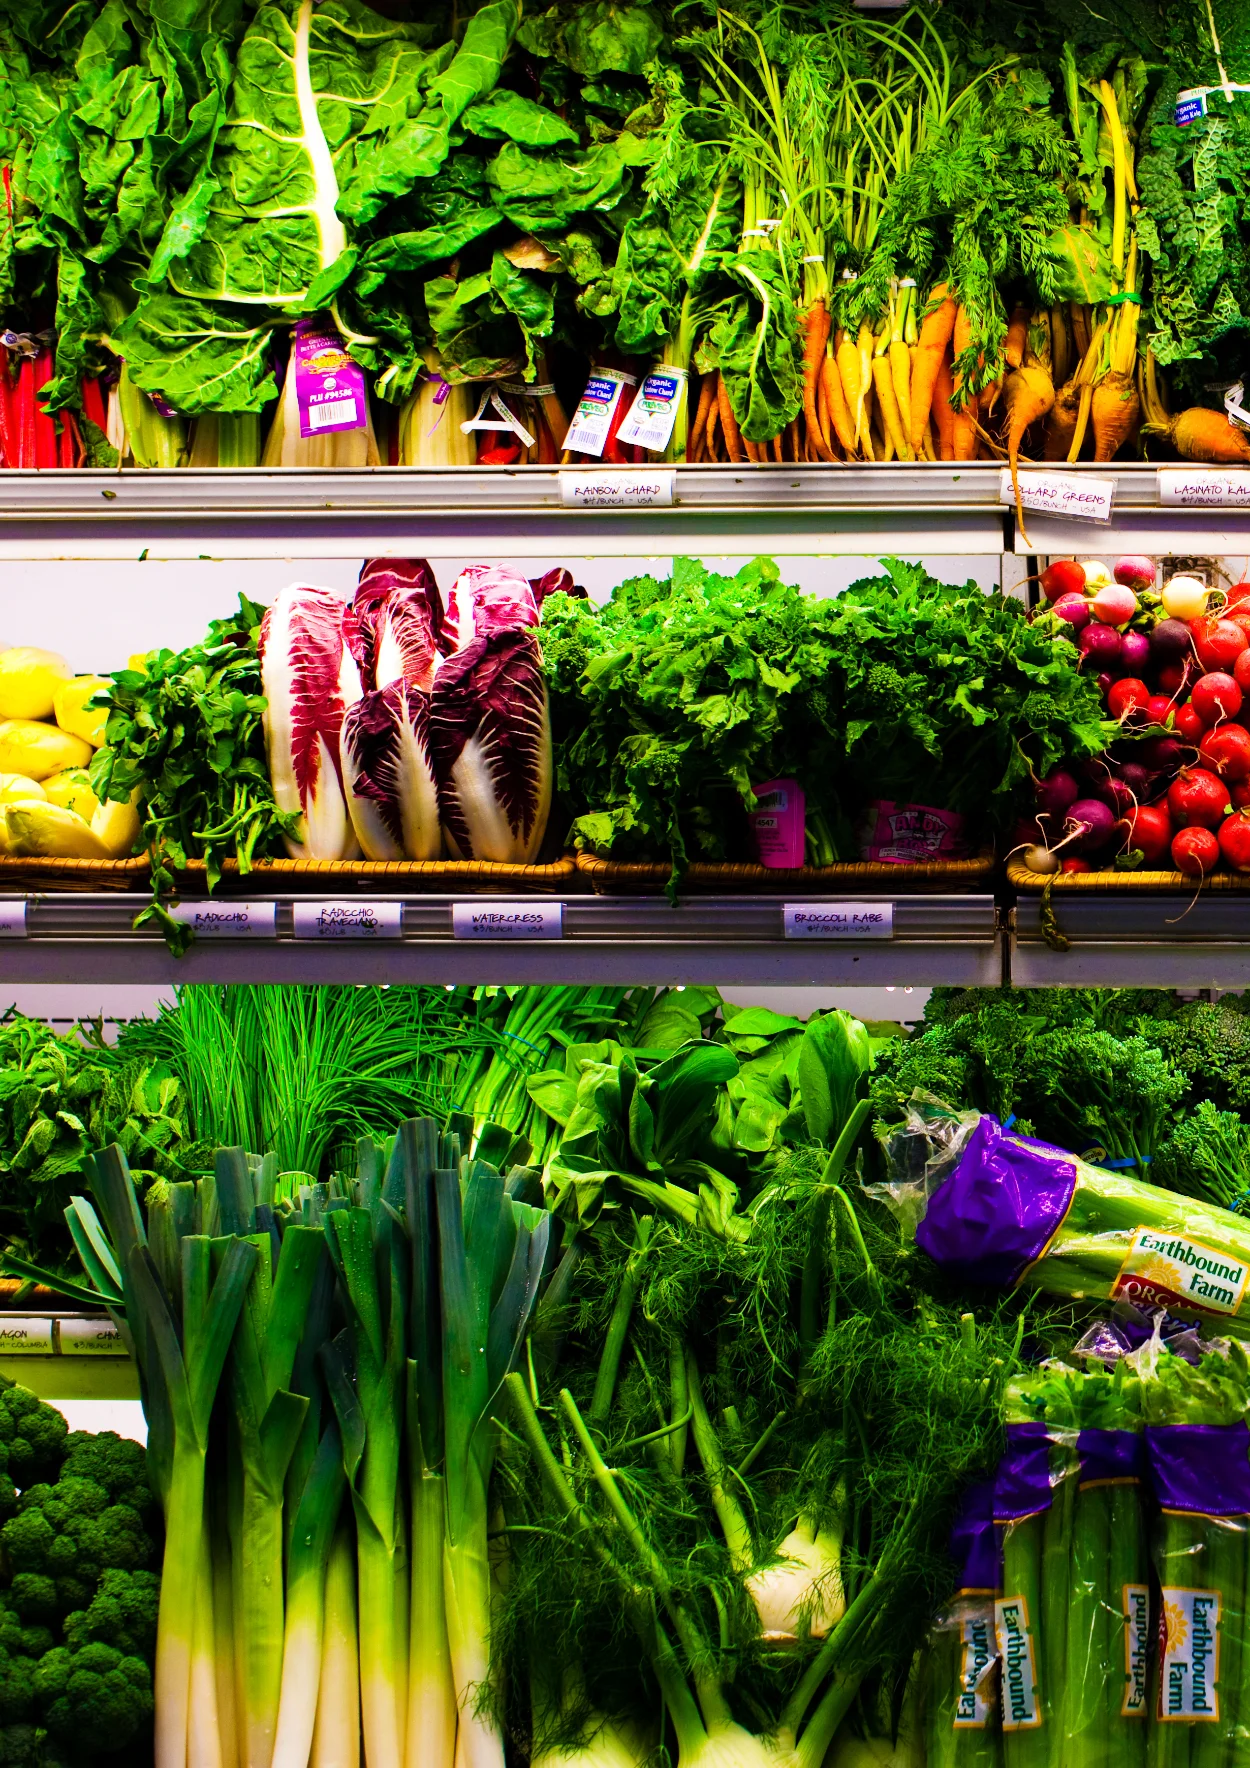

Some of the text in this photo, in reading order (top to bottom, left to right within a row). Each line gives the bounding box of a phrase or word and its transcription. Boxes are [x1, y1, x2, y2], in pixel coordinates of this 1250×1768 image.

[309, 394, 323, 403] PLU
[575, 485, 661, 496] RAINBOW CHARD
[1174, 485, 1223, 495] LASINATO
[583, 497, 624, 505] $4/BUNCH
[637, 497, 654, 505] USA
[1063, 491, 1106, 504] GREENS
[1080, 506, 1096, 514] USA
[321, 908, 374, 917] RADICCHIO
[795, 912, 884, 923] BROCCOLI RABE
[195, 913, 249, 923] RADICCHIO
[472, 914, 544, 924] WATERCRESS
[236, 924, 252, 932] USA
[362, 928, 378, 936] USA
[473, 925, 513, 933] $3/BUNCH
[527, 925, 544, 933] USA
[807, 924, 848, 933] $4/BUNCH
[1140, 1235, 1244, 1284] Earthbound
[1125, 1280, 1183, 1308] ORGA
[1189, 1272, 1235, 1306] Farm
[97, 1331, 121, 1340] CHIVE
[73, 1341, 113, 1350] $3/BUNCH
[1127, 1593, 1147, 1709] Earthbound
[1191, 1597, 1214, 1712] Earthbound
[1002, 1605, 1033, 1721] Earthbound
[1168, 1662, 1188, 1714] Farm
